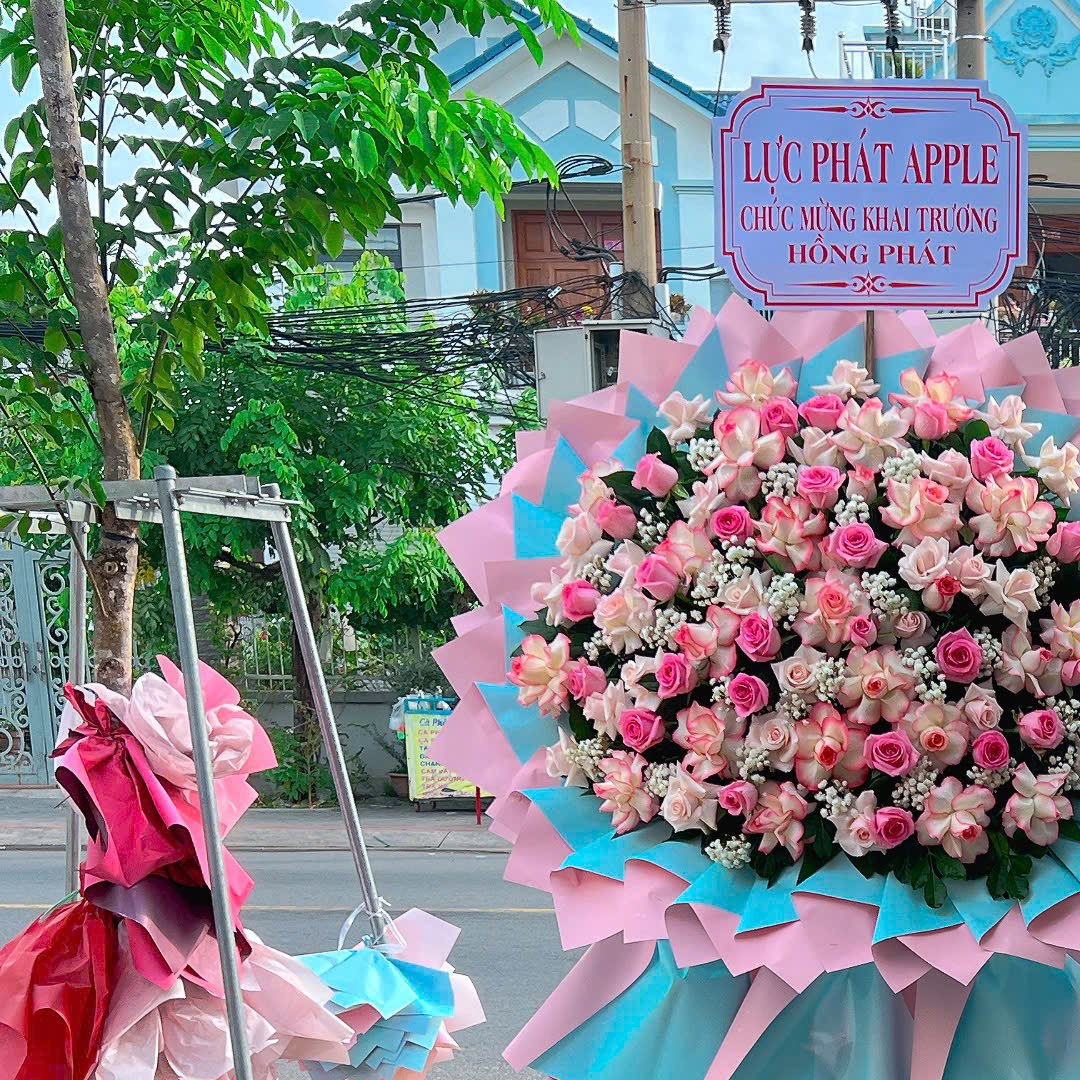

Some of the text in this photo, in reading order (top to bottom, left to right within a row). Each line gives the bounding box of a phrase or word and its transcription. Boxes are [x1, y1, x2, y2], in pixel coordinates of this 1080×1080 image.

[743, 127, 1000, 195] LỰC PHÁT APPLE
[740, 198, 998, 234] CHÚC MỪNG KHAI TRƯƠNG
[788, 233, 957, 266] HỒNG PHÁT
